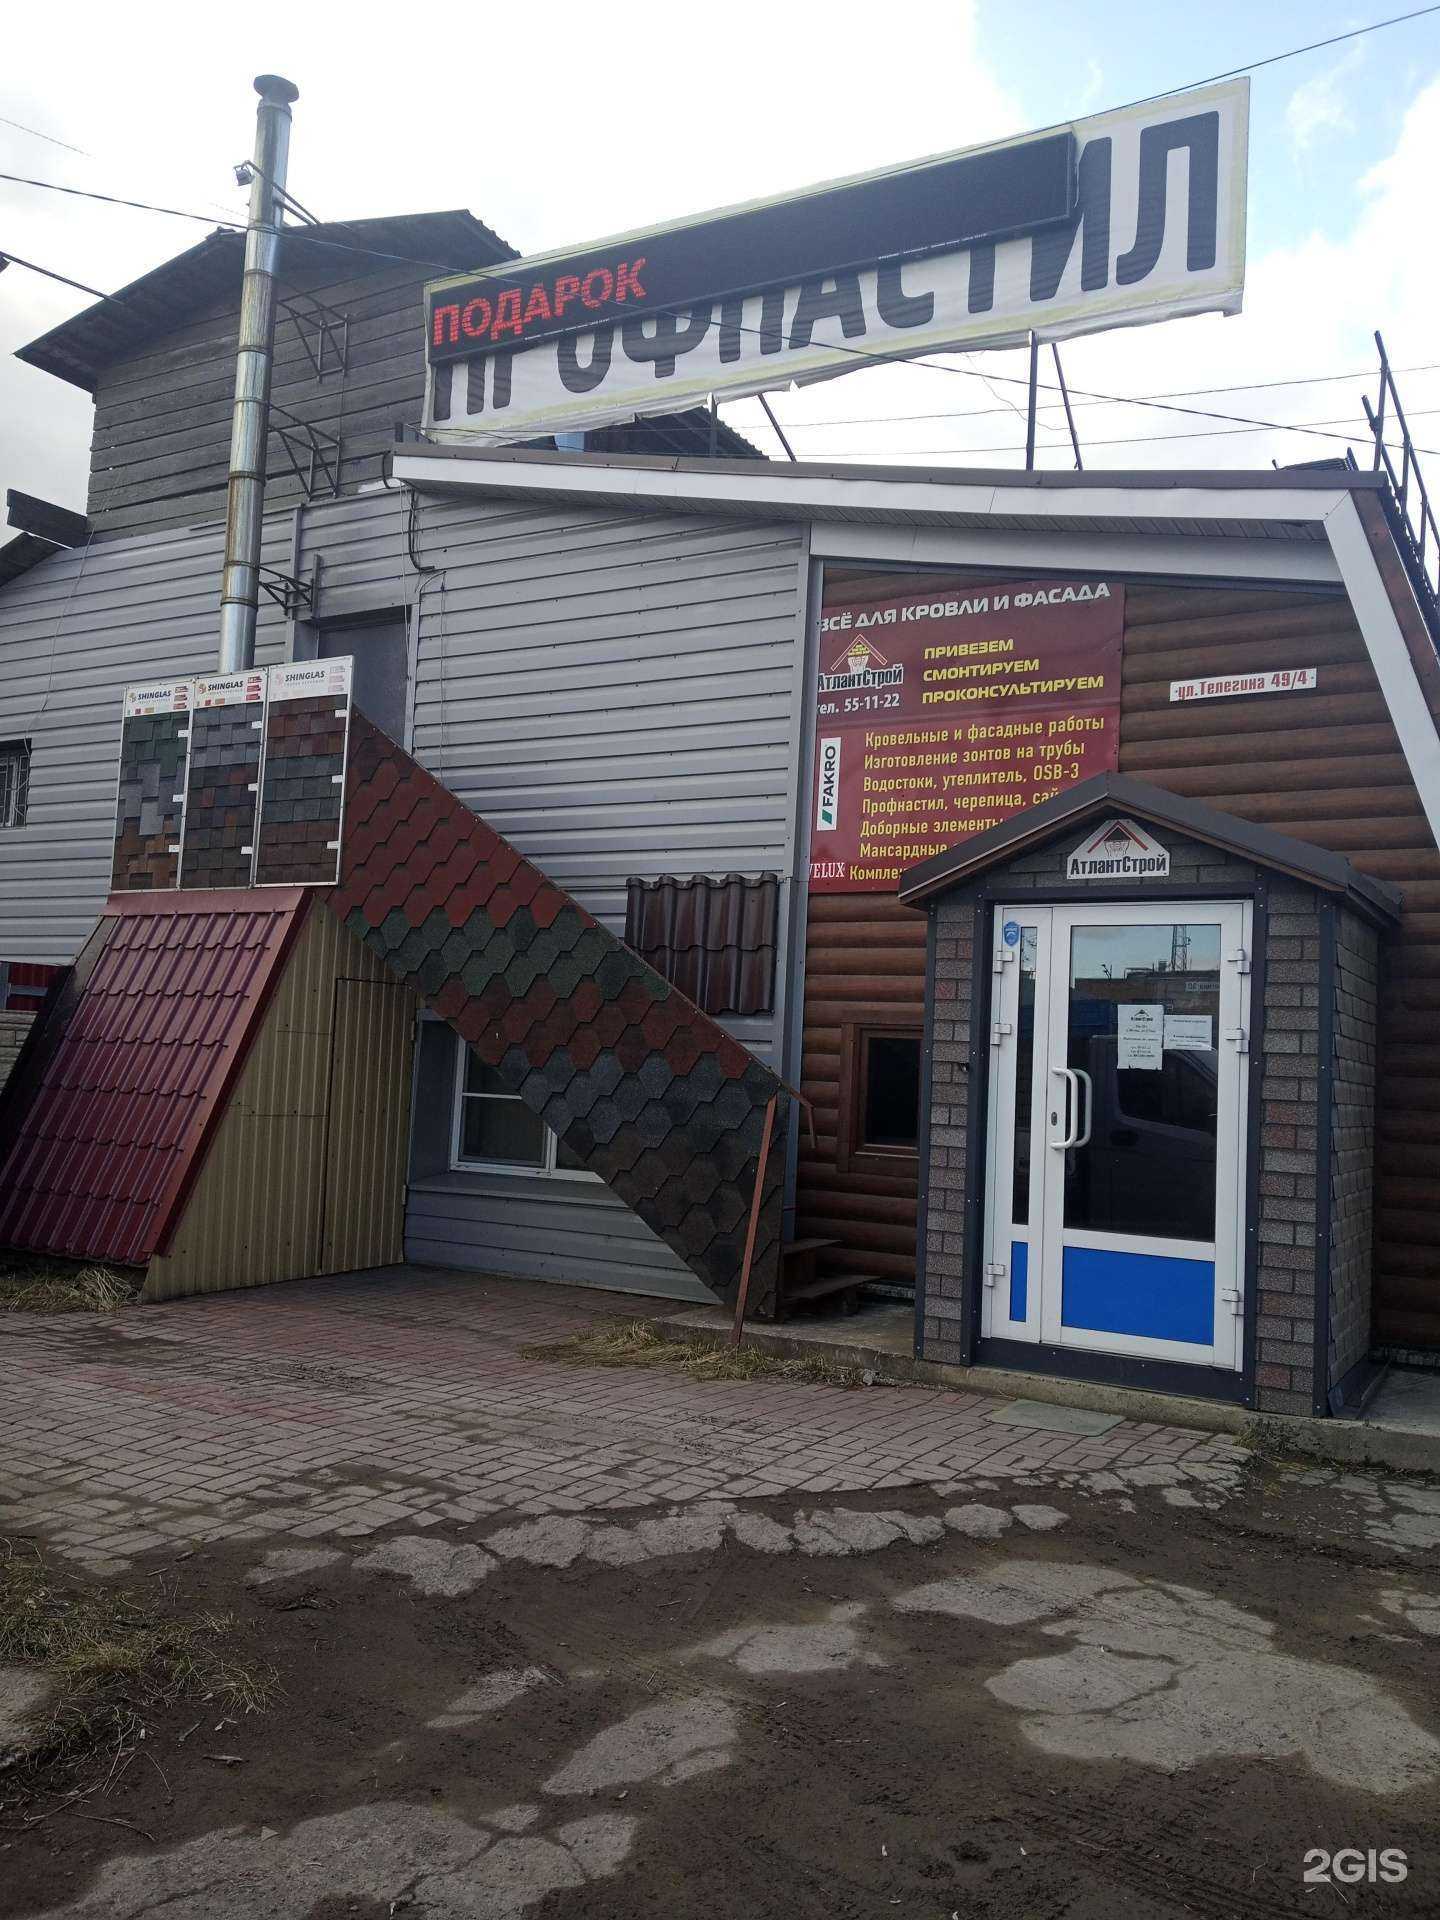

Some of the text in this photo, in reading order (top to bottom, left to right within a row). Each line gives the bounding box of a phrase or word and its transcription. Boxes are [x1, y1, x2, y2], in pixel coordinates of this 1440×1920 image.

[433, 257, 647, 346] ПОДАРОК
[855, 609, 896, 628] ДЛЯ
[901, 598, 988, 622] КРОВЛИ
[994, 594, 1010, 611] И
[1014, 583, 1111, 608] ФАСАДА
[924, 638, 1014, 660] ПРИВЕЗЕМ
[285, 670, 325, 682] SHINGLAS
[818, 664, 904, 692] АтлантСтрой
[923, 659, 1040, 682] СМОНТИРУЕМ
[1271, 670, 1308, 689] 49/4
[137, 690, 171, 701] SHINGLAS
[208, 680, 244, 692] SHINGLAS
[922, 676, 1104, 704] ПРОКОНСУЛЬТИРУЕМ
[817, 693, 900, 715] ел. 55-11-22
[866, 716, 1104, 750] Кровельные и фасадные работы
[865, 740, 1085, 770] Изготовление зонтов на трубы
[823, 745, 836, 807] FAKRO
[864, 763, 1080, 793] Водостоки, утеплитель, OSB-3
[862, 798, 948, 817] Профнастил,
[954, 793, 1027, 811] черепица,
[860, 820, 928, 838] Доборные
[860, 843, 948, 860] Мансардные
[1070, 853, 1166, 875] АтлантСтрой
